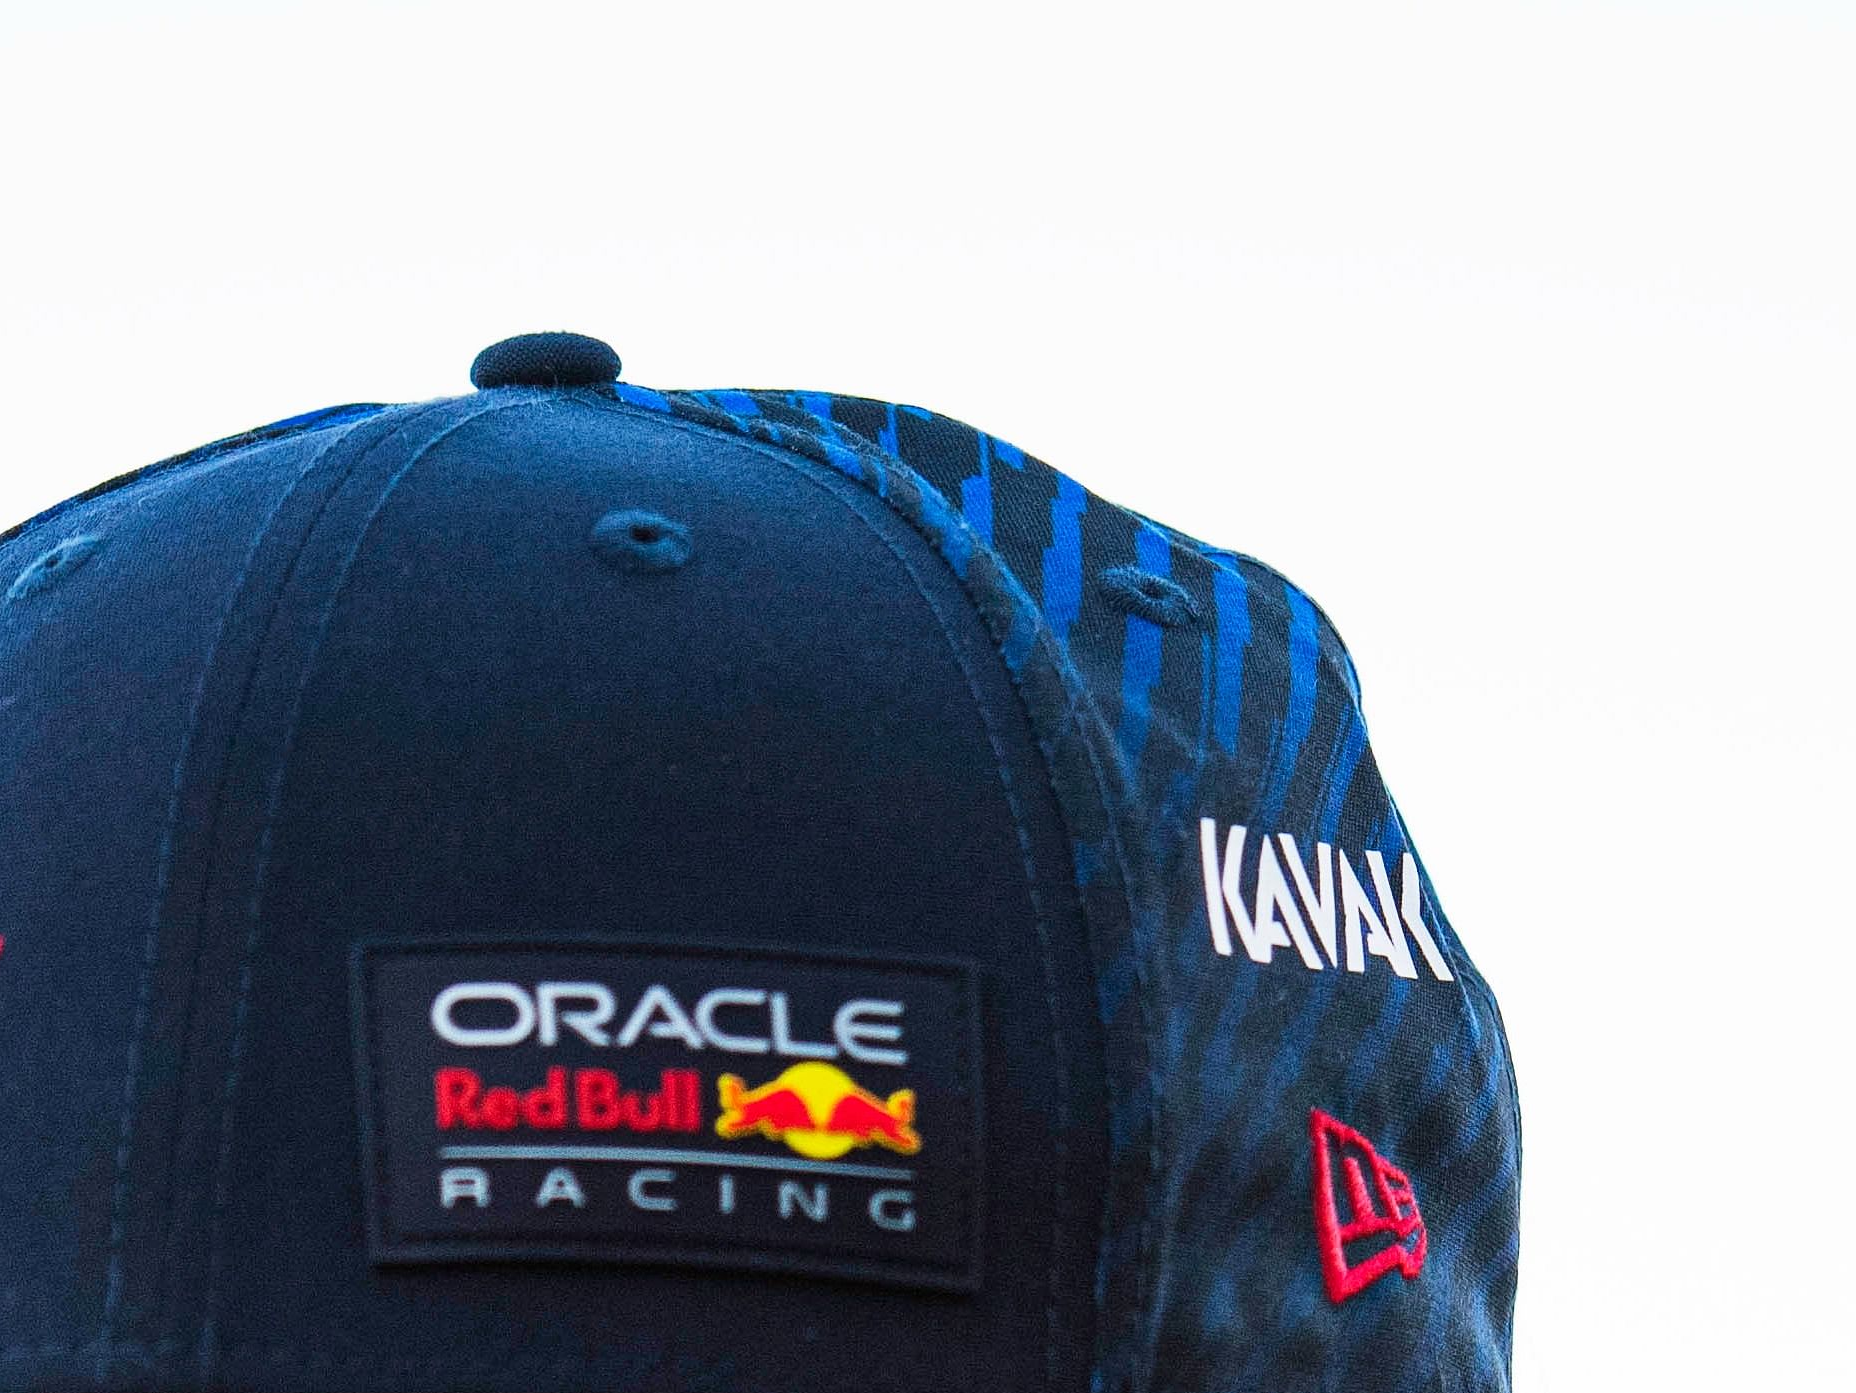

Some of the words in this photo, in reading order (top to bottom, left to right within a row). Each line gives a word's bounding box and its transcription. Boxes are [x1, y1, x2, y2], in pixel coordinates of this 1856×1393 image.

[1200, 817, 1454, 981] KAVAK
[430, 981, 909, 1066] ORACLE
[434, 1065, 567, 1130] Red
[575, 1066, 701, 1133] Bull
[440, 1166, 916, 1232] RACING
